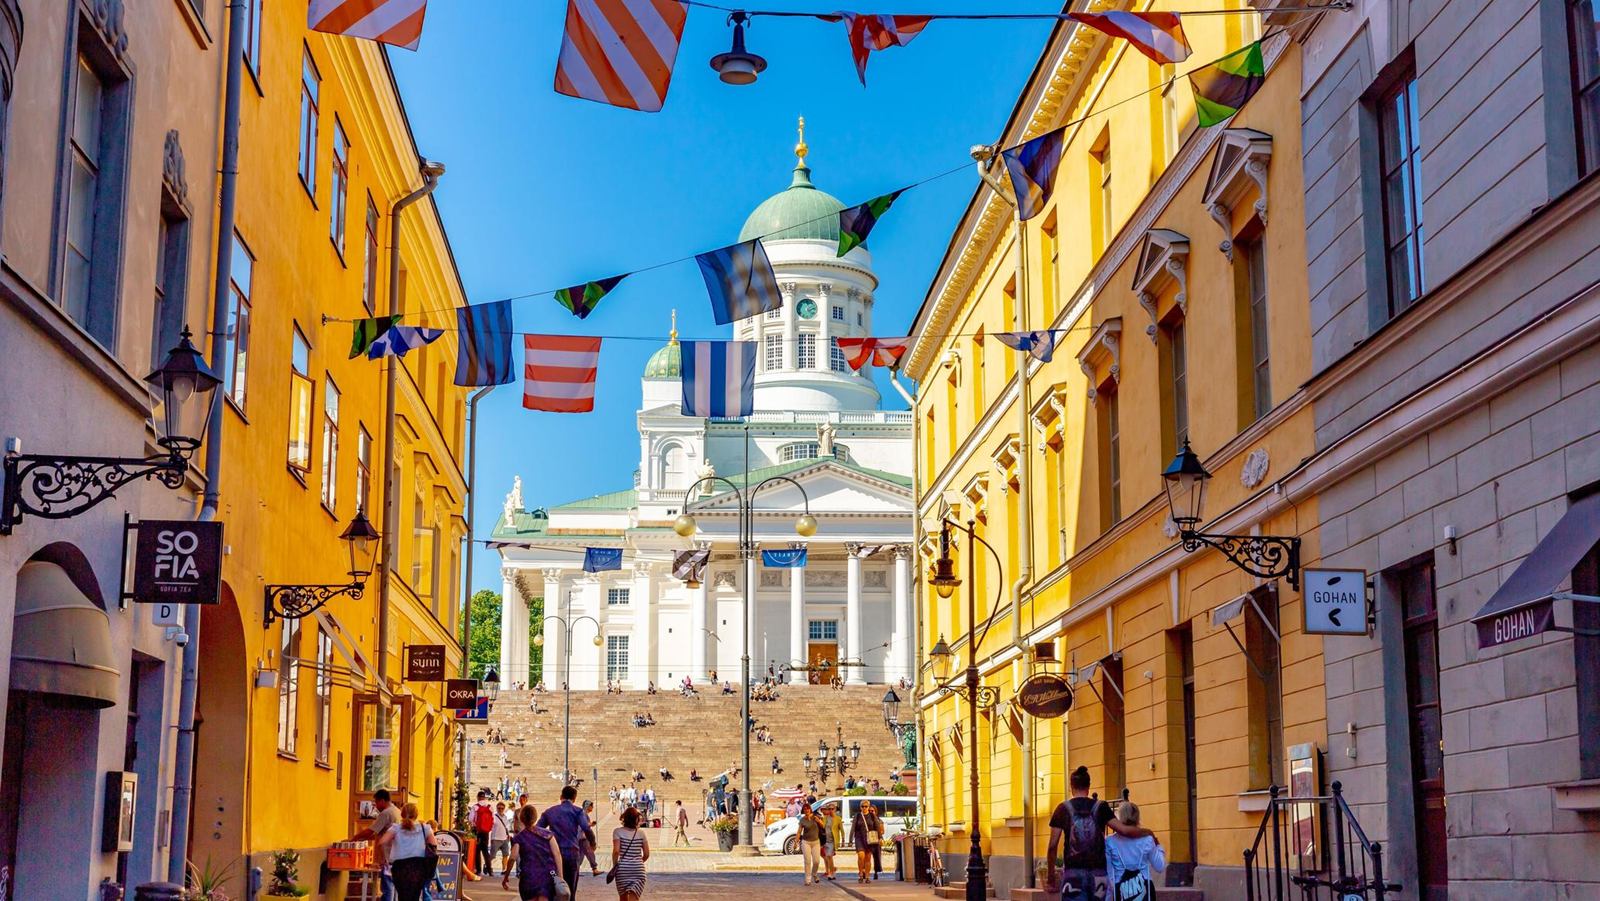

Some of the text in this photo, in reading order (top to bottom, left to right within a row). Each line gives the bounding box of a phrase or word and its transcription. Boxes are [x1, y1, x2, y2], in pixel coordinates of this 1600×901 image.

[156, 531, 198, 554] SO
[154, 555, 200, 579] FIA
[1313, 591, 1357, 604] GOHAN
[160, 605, 171, 618] D
[1494, 609, 1535, 643] GOHAN
[412, 658, 440, 668] synn
[450, 690, 474, 699] OKRA
